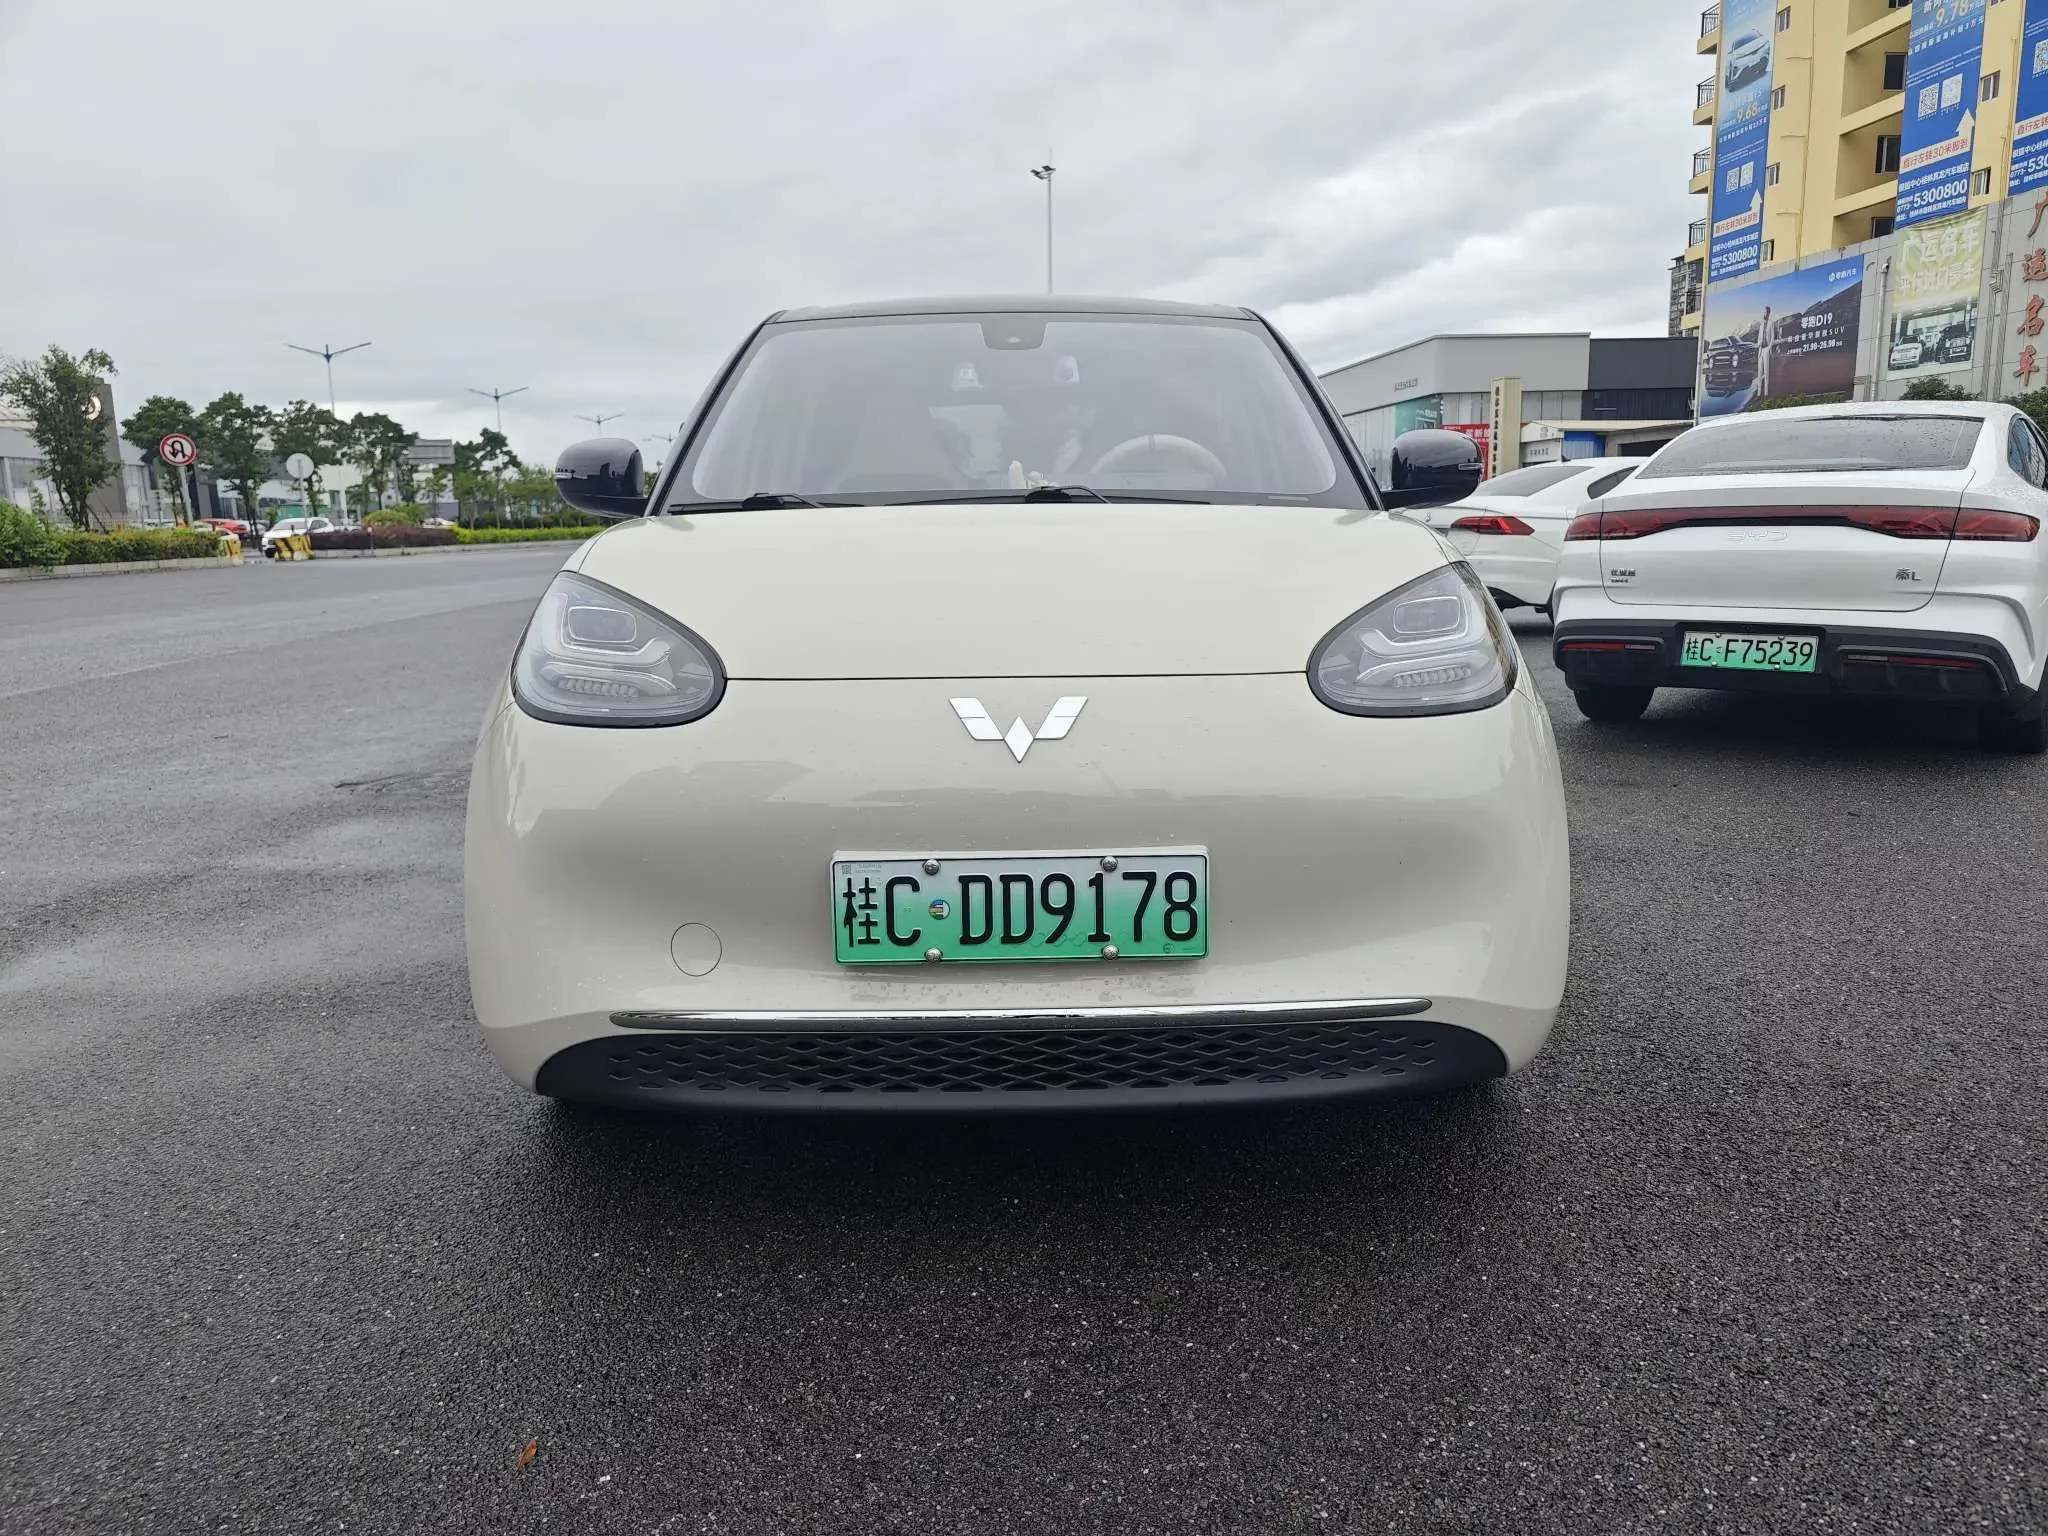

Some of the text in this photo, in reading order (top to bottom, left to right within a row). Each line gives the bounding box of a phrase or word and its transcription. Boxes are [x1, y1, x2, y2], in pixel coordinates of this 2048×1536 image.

[1913, 179, 1968, 207] 5300800
[1722, 245, 1758, 266] 5300800
[1724, 639, 1813, 666] F75239
[958, 871, 1198, 945] DD9178
